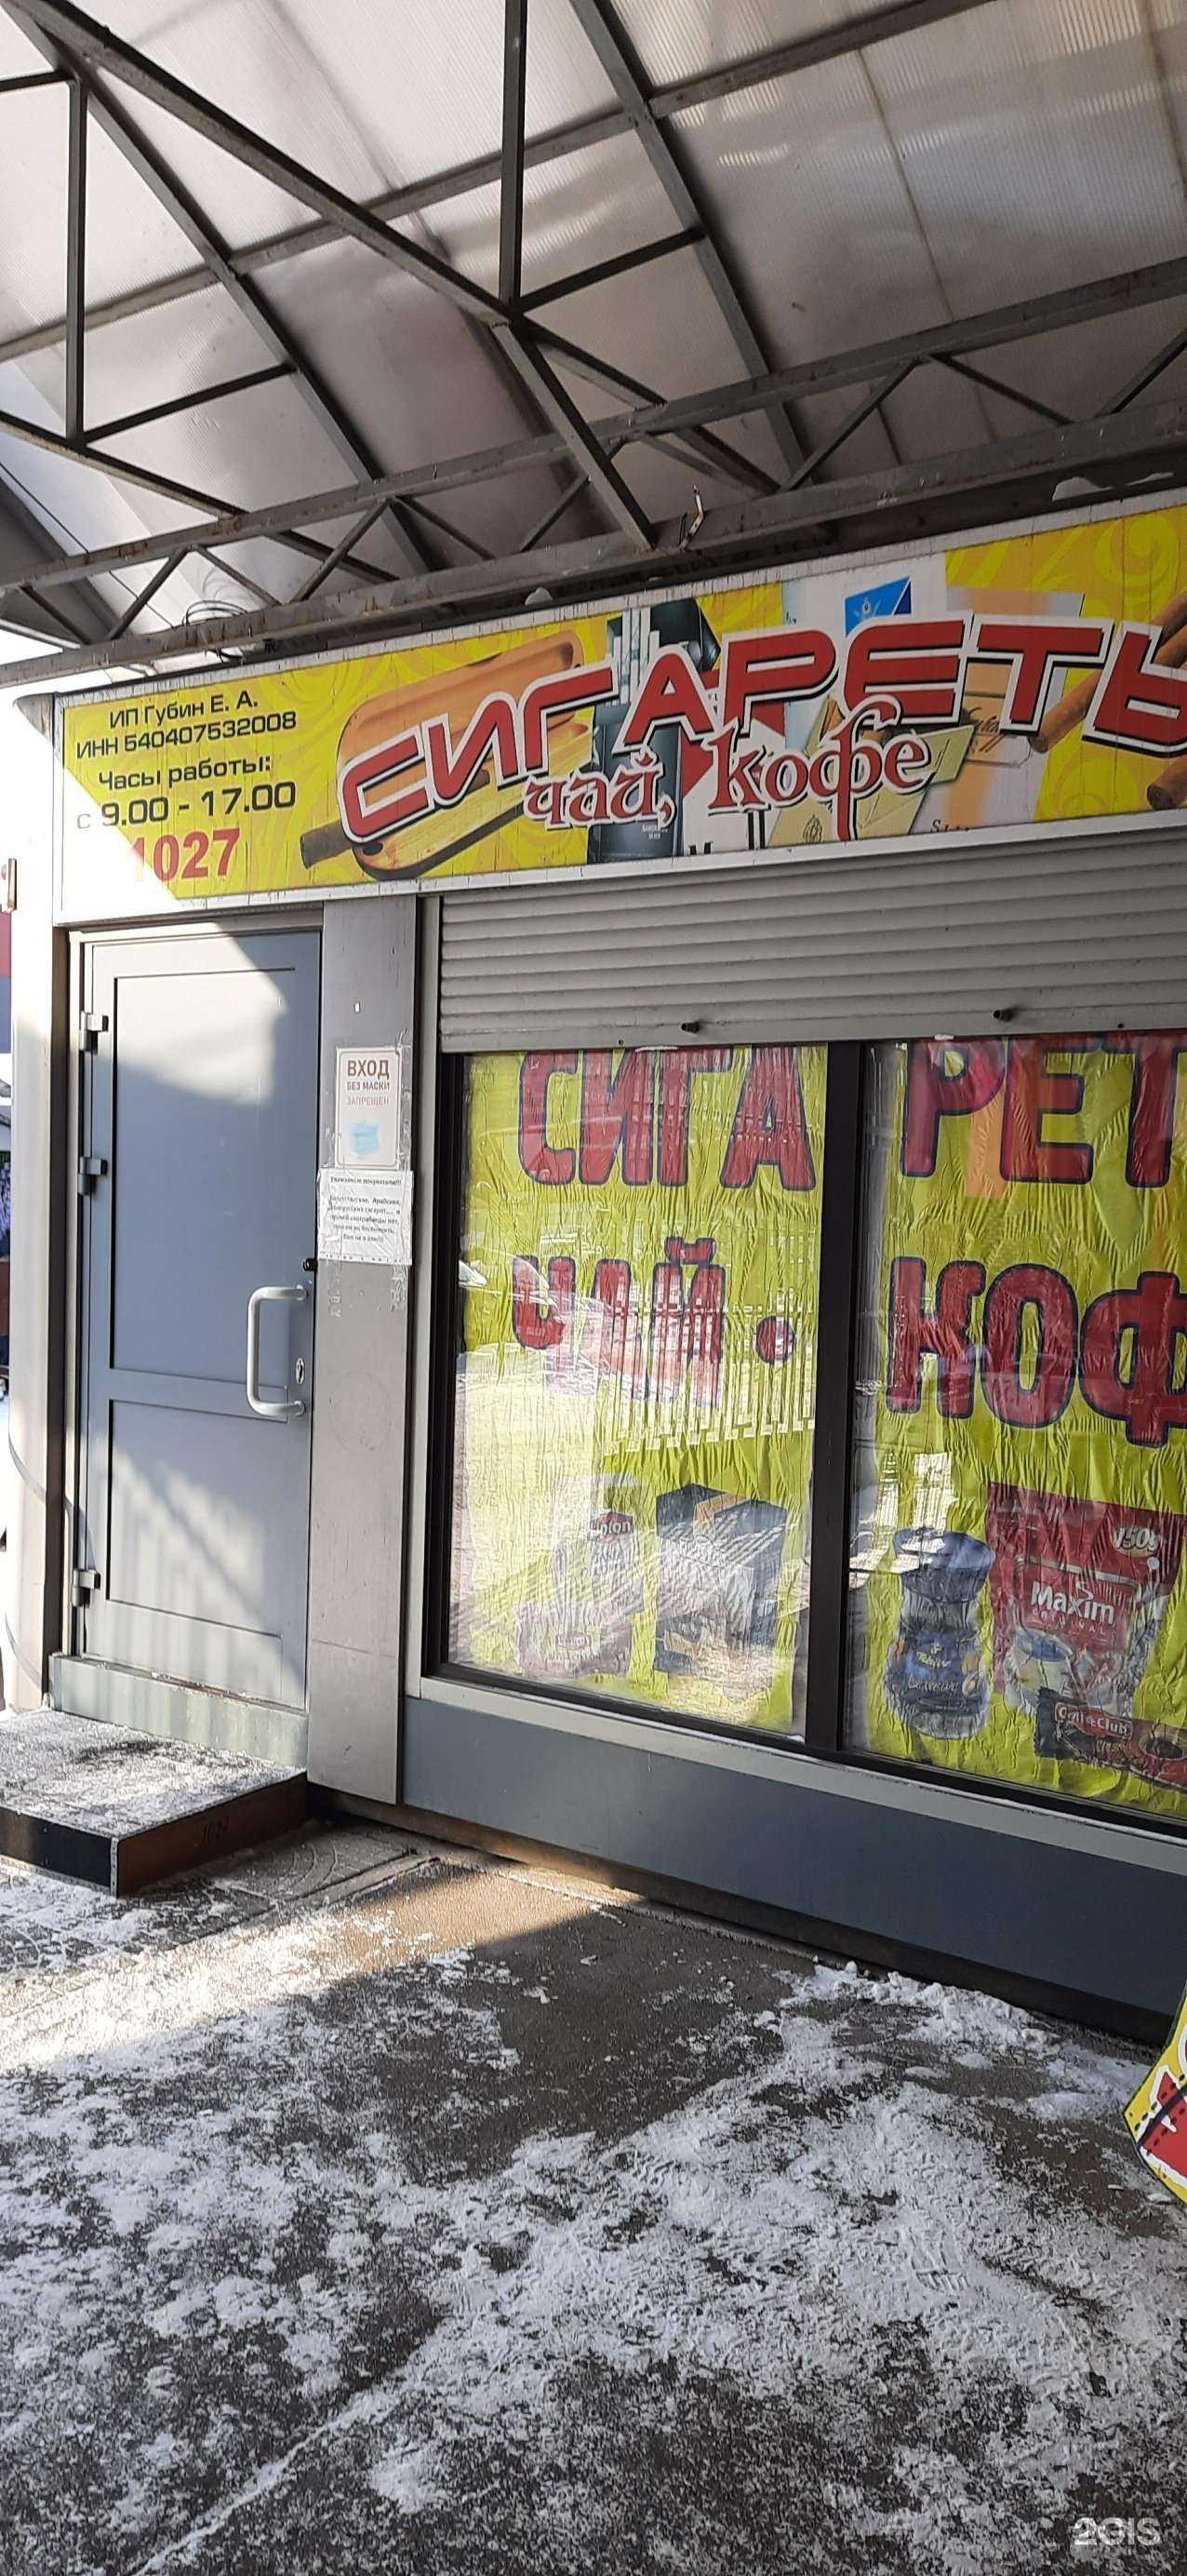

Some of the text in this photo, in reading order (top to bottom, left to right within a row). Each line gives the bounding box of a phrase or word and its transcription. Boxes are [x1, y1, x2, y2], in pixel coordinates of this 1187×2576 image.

[109, 690, 259, 730] ИП Губин Е. А.
[76, 711, 297, 760] ИНН 540407532008
[99, 755, 272, 792] Часы работы:
[525, 696, 931, 842] чай, кофе
[100, 796, 169, 827] 9.00
[200, 781, 297, 818] 17.00
[131, 826, 240, 883] 1027
[346, 1080, 390, 1091] БЕЗ МАСКИ
[347, 1059, 390, 1080] ВХОД
[346, 1096, 389, 1107] ЗАПРЕЩЕН
[517, 1045, 818, 1192] СИГА
[511, 1236, 727, 1410] ЧАЙ
[1031, 1580, 1115, 1626] Maxim
